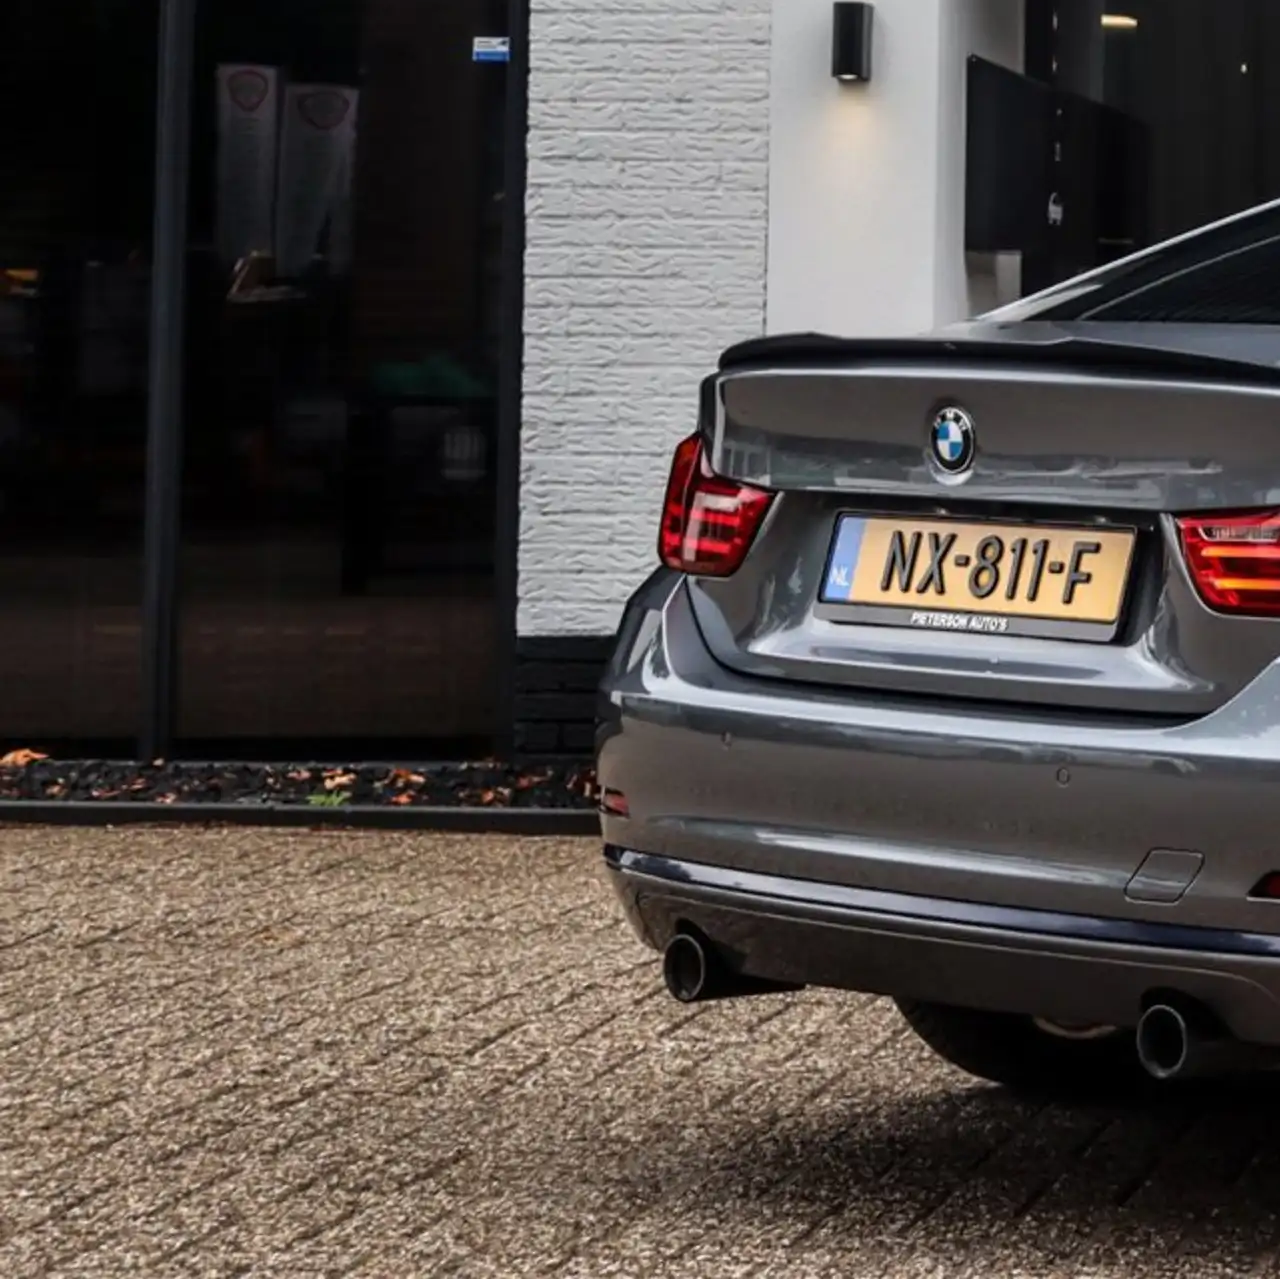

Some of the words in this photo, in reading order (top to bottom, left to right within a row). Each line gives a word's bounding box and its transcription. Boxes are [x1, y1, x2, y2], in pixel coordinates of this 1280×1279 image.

[830, 566, 849, 586] NL
[880, 530, 1102, 605] NX-811-F
[911, 612, 967, 629] PIETERSON
